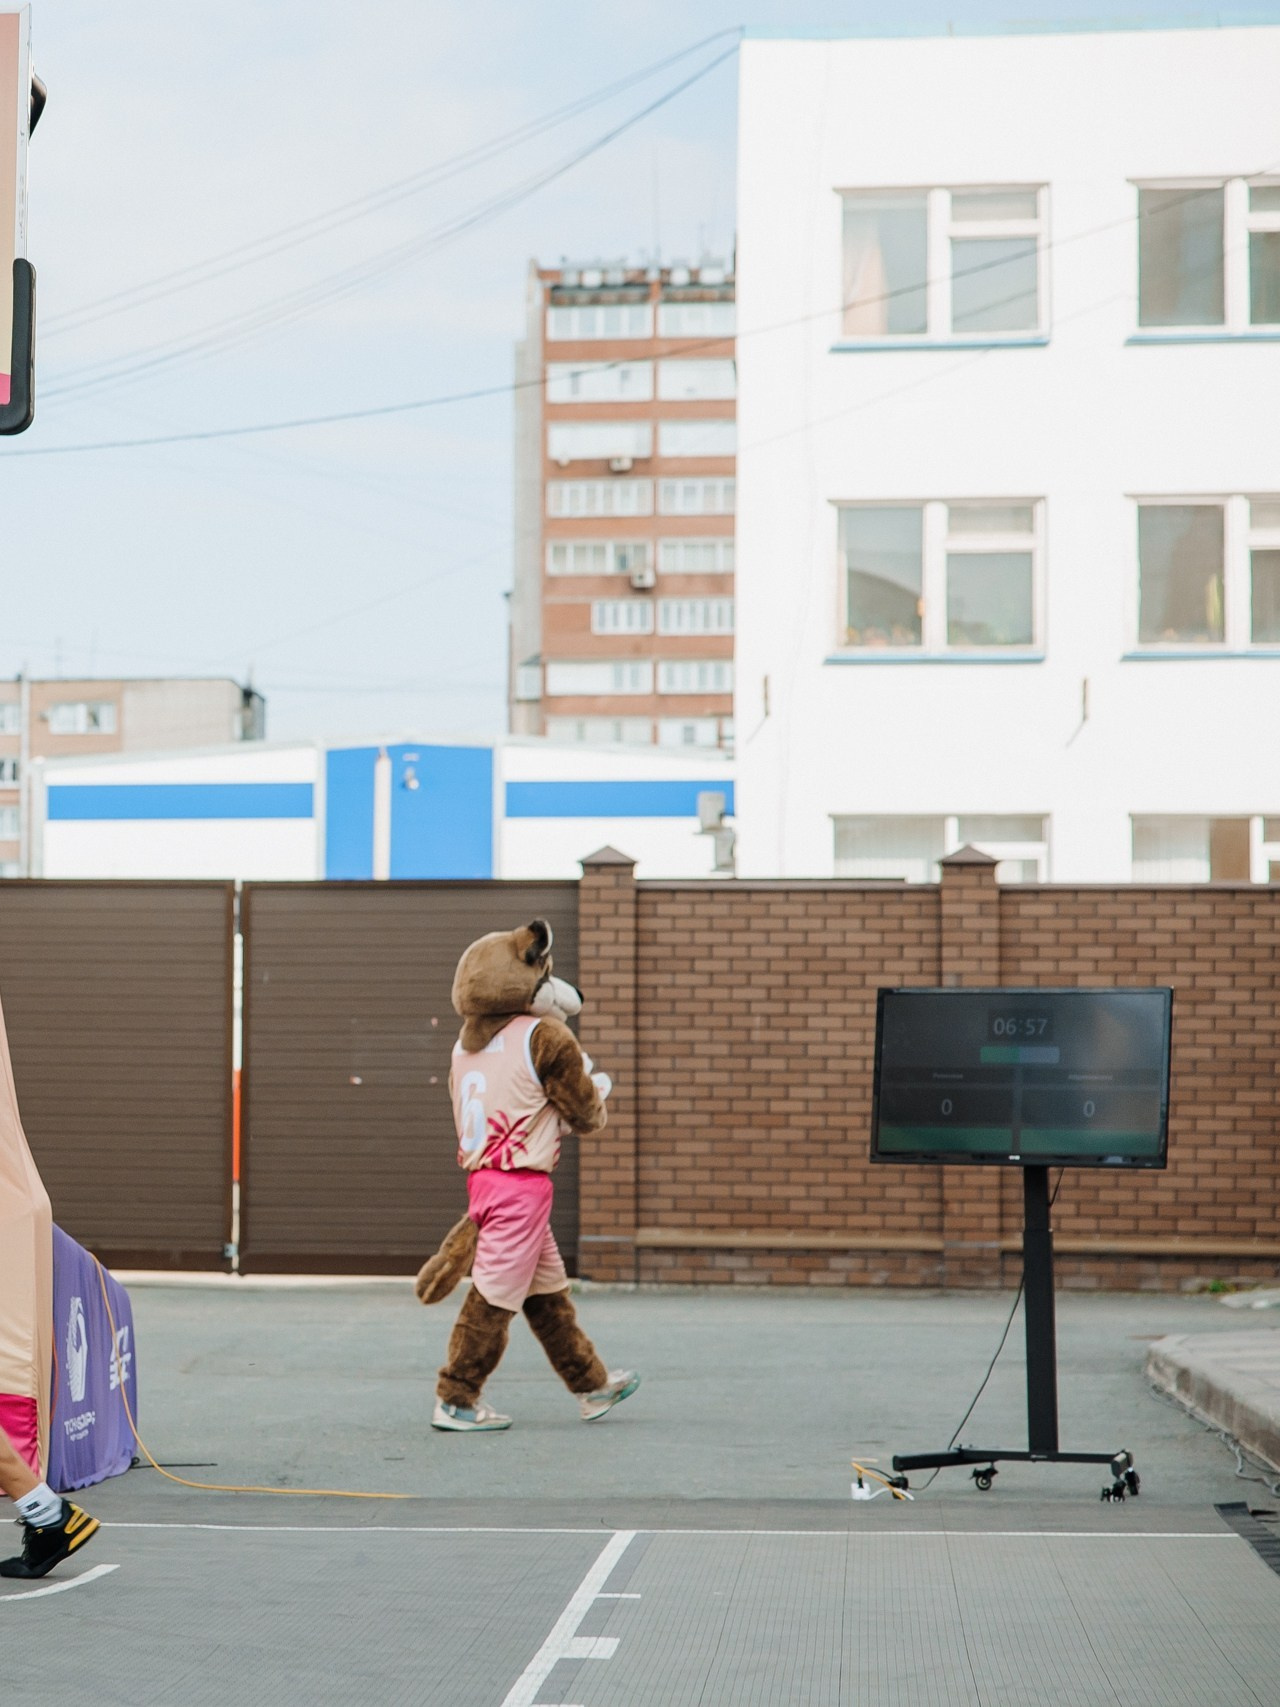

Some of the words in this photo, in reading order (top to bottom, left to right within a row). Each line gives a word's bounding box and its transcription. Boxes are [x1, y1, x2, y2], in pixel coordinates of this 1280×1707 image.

[461, 1070, 486, 1152] 6
[941, 1098, 953, 1116] 0
[1082, 1100, 1096, 1118] 0
